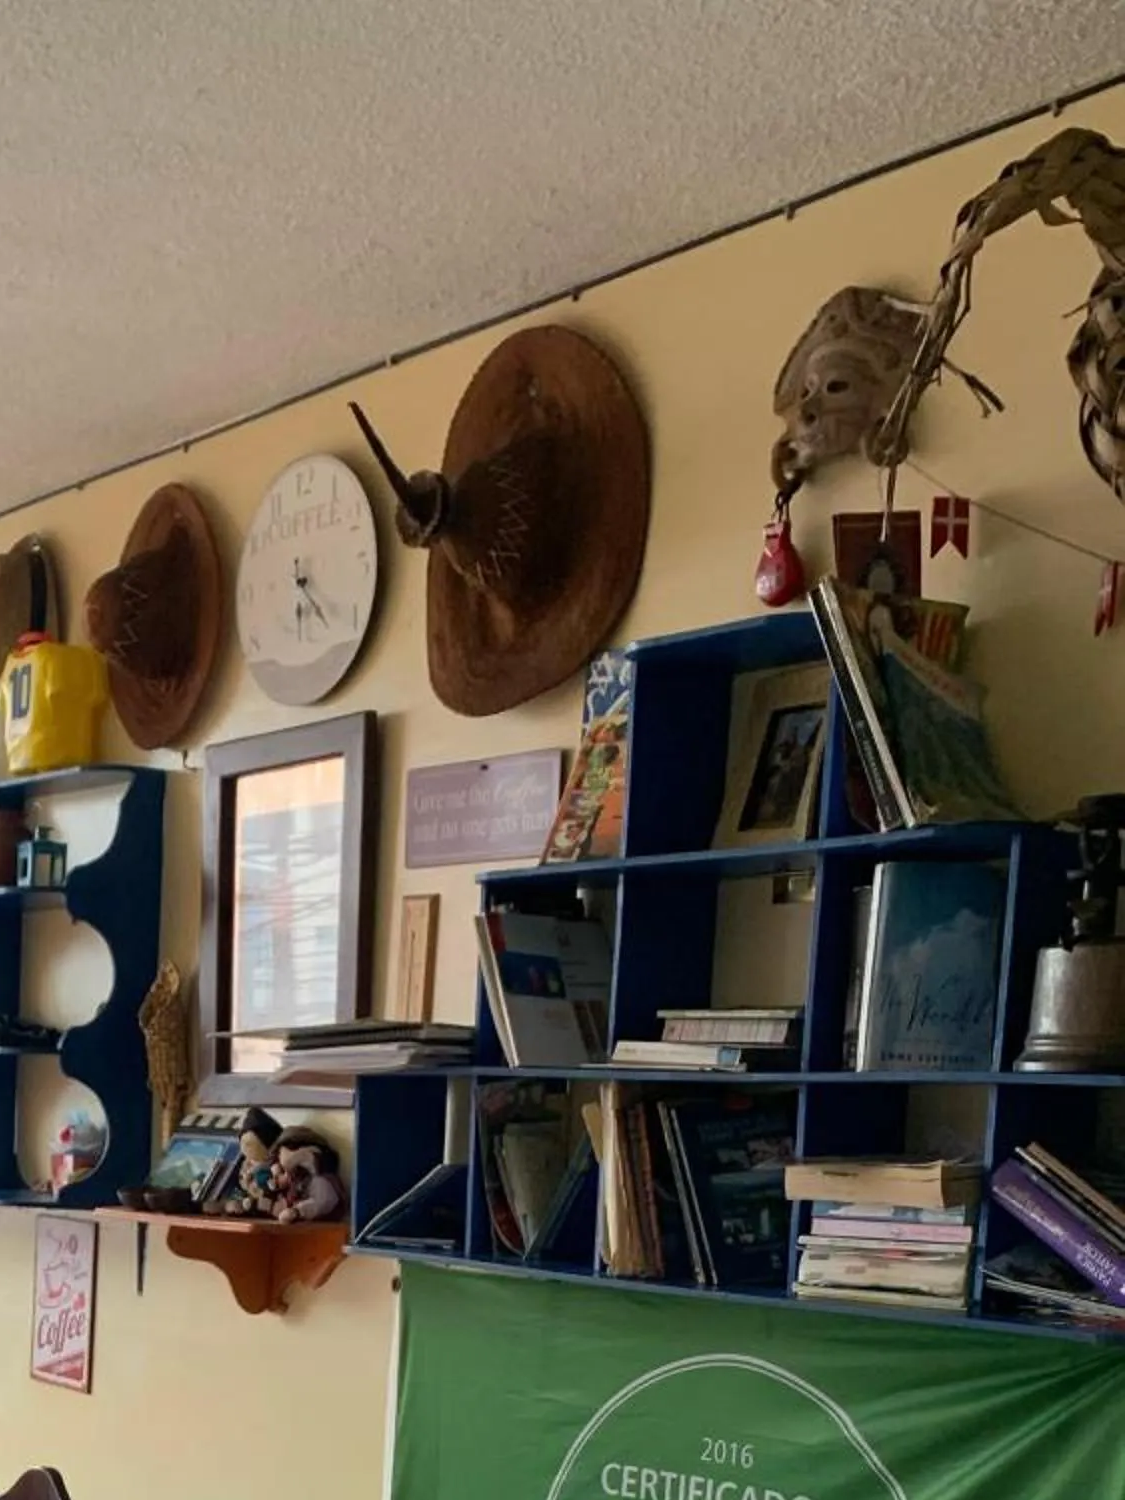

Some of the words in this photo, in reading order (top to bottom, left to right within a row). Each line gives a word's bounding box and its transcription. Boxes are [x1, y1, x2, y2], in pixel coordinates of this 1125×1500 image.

[266, 501, 343, 542] COFFEE
[9, 664, 32, 720] 10
[37, 1308, 87, 1354] Coffee
[700, 1437, 755, 1469] 2016
